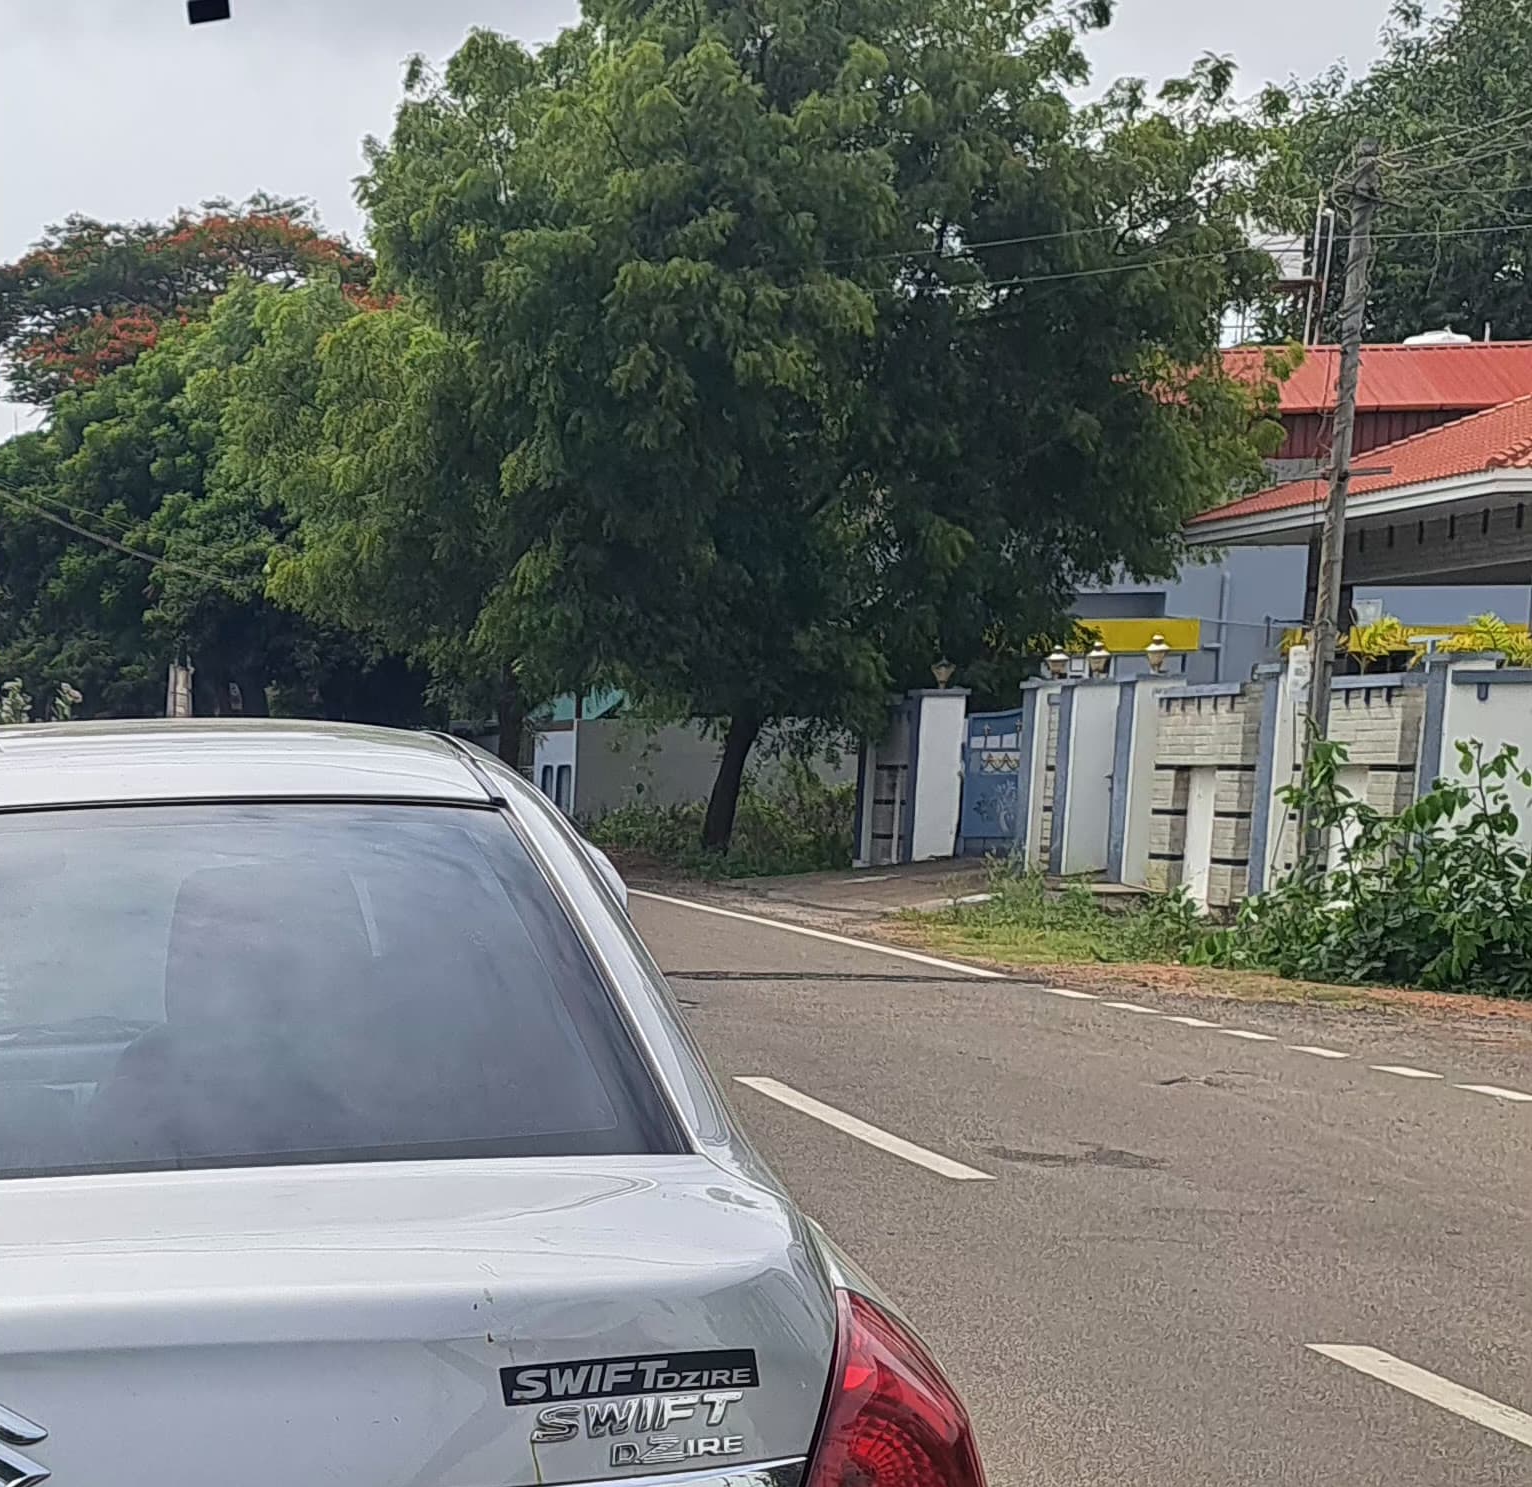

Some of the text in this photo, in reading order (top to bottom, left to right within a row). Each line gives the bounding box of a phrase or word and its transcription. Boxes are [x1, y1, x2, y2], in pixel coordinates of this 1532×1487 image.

[512, 1360, 752, 1400] SWIFT DZIRE
[530, 1391, 744, 1444] SWIFT
[610, 1434, 745, 1467] DZIRE
